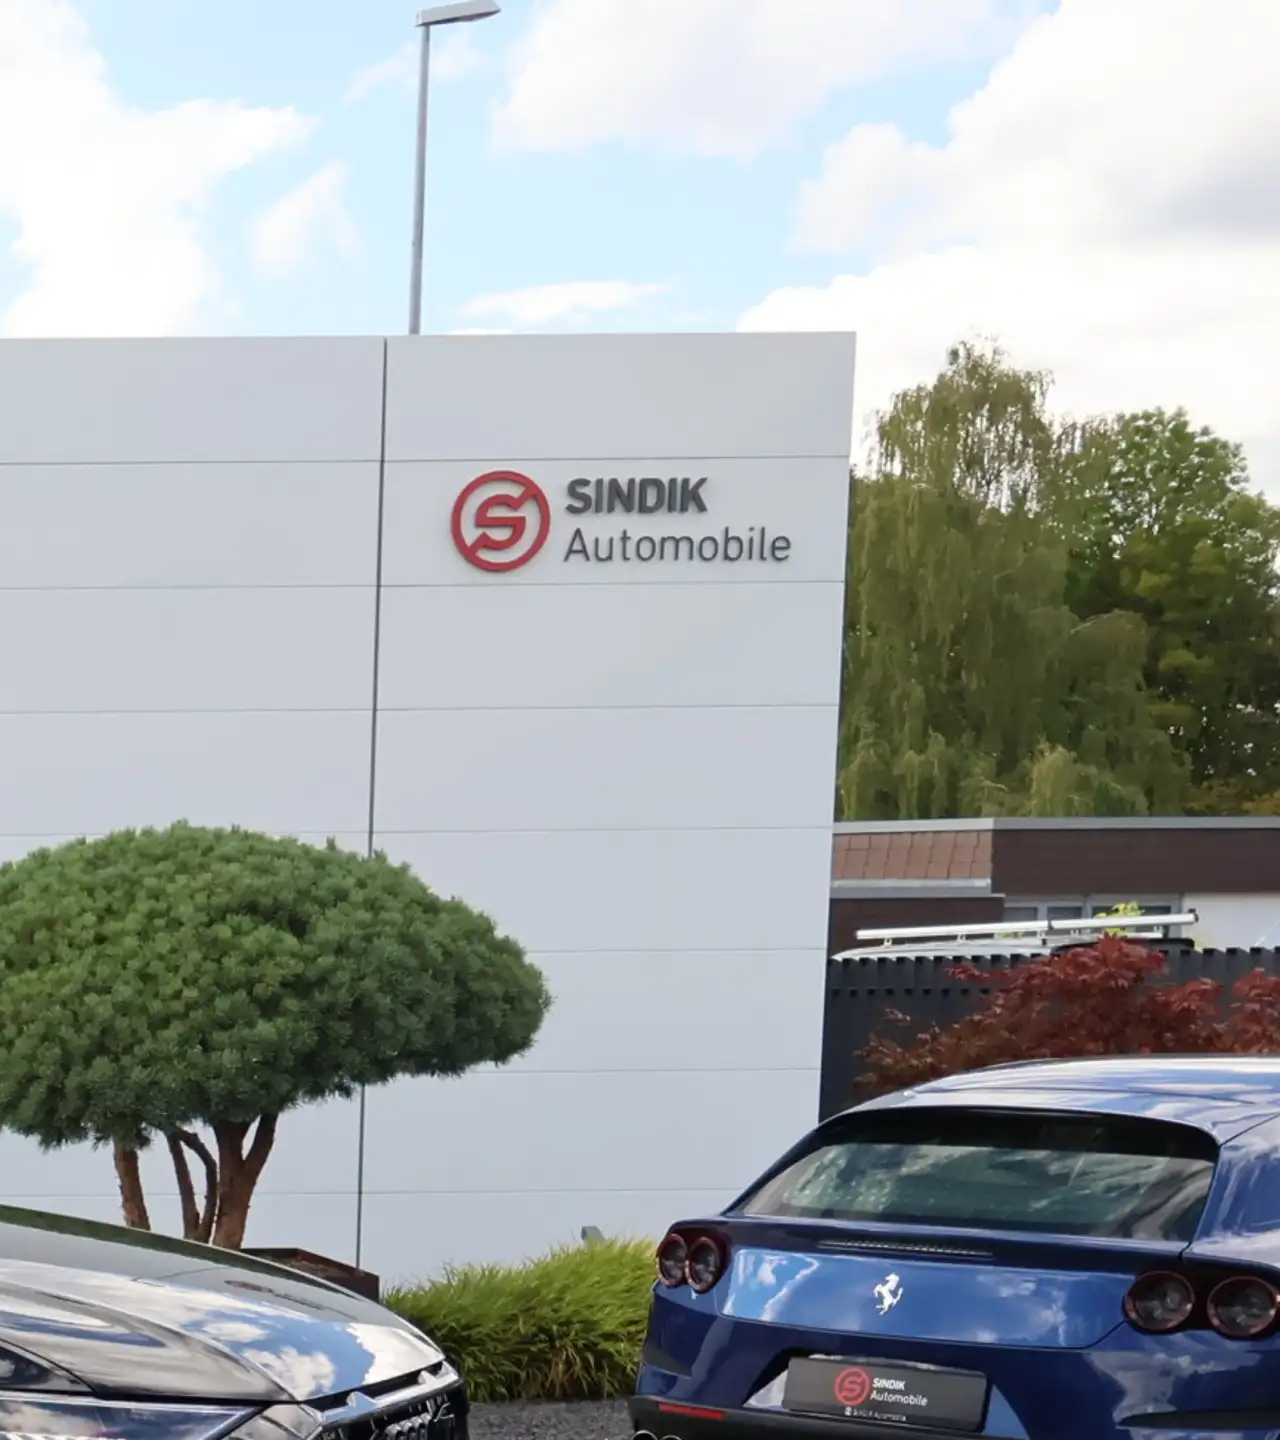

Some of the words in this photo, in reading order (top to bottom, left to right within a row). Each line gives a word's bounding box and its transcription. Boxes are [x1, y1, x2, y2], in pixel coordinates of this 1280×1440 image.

[565, 477, 709, 514] SINDIK
[563, 526, 792, 563] Automobile
[872, 1377, 905, 1391] SINDIK
[870, 1390, 928, 1406] Automobile
